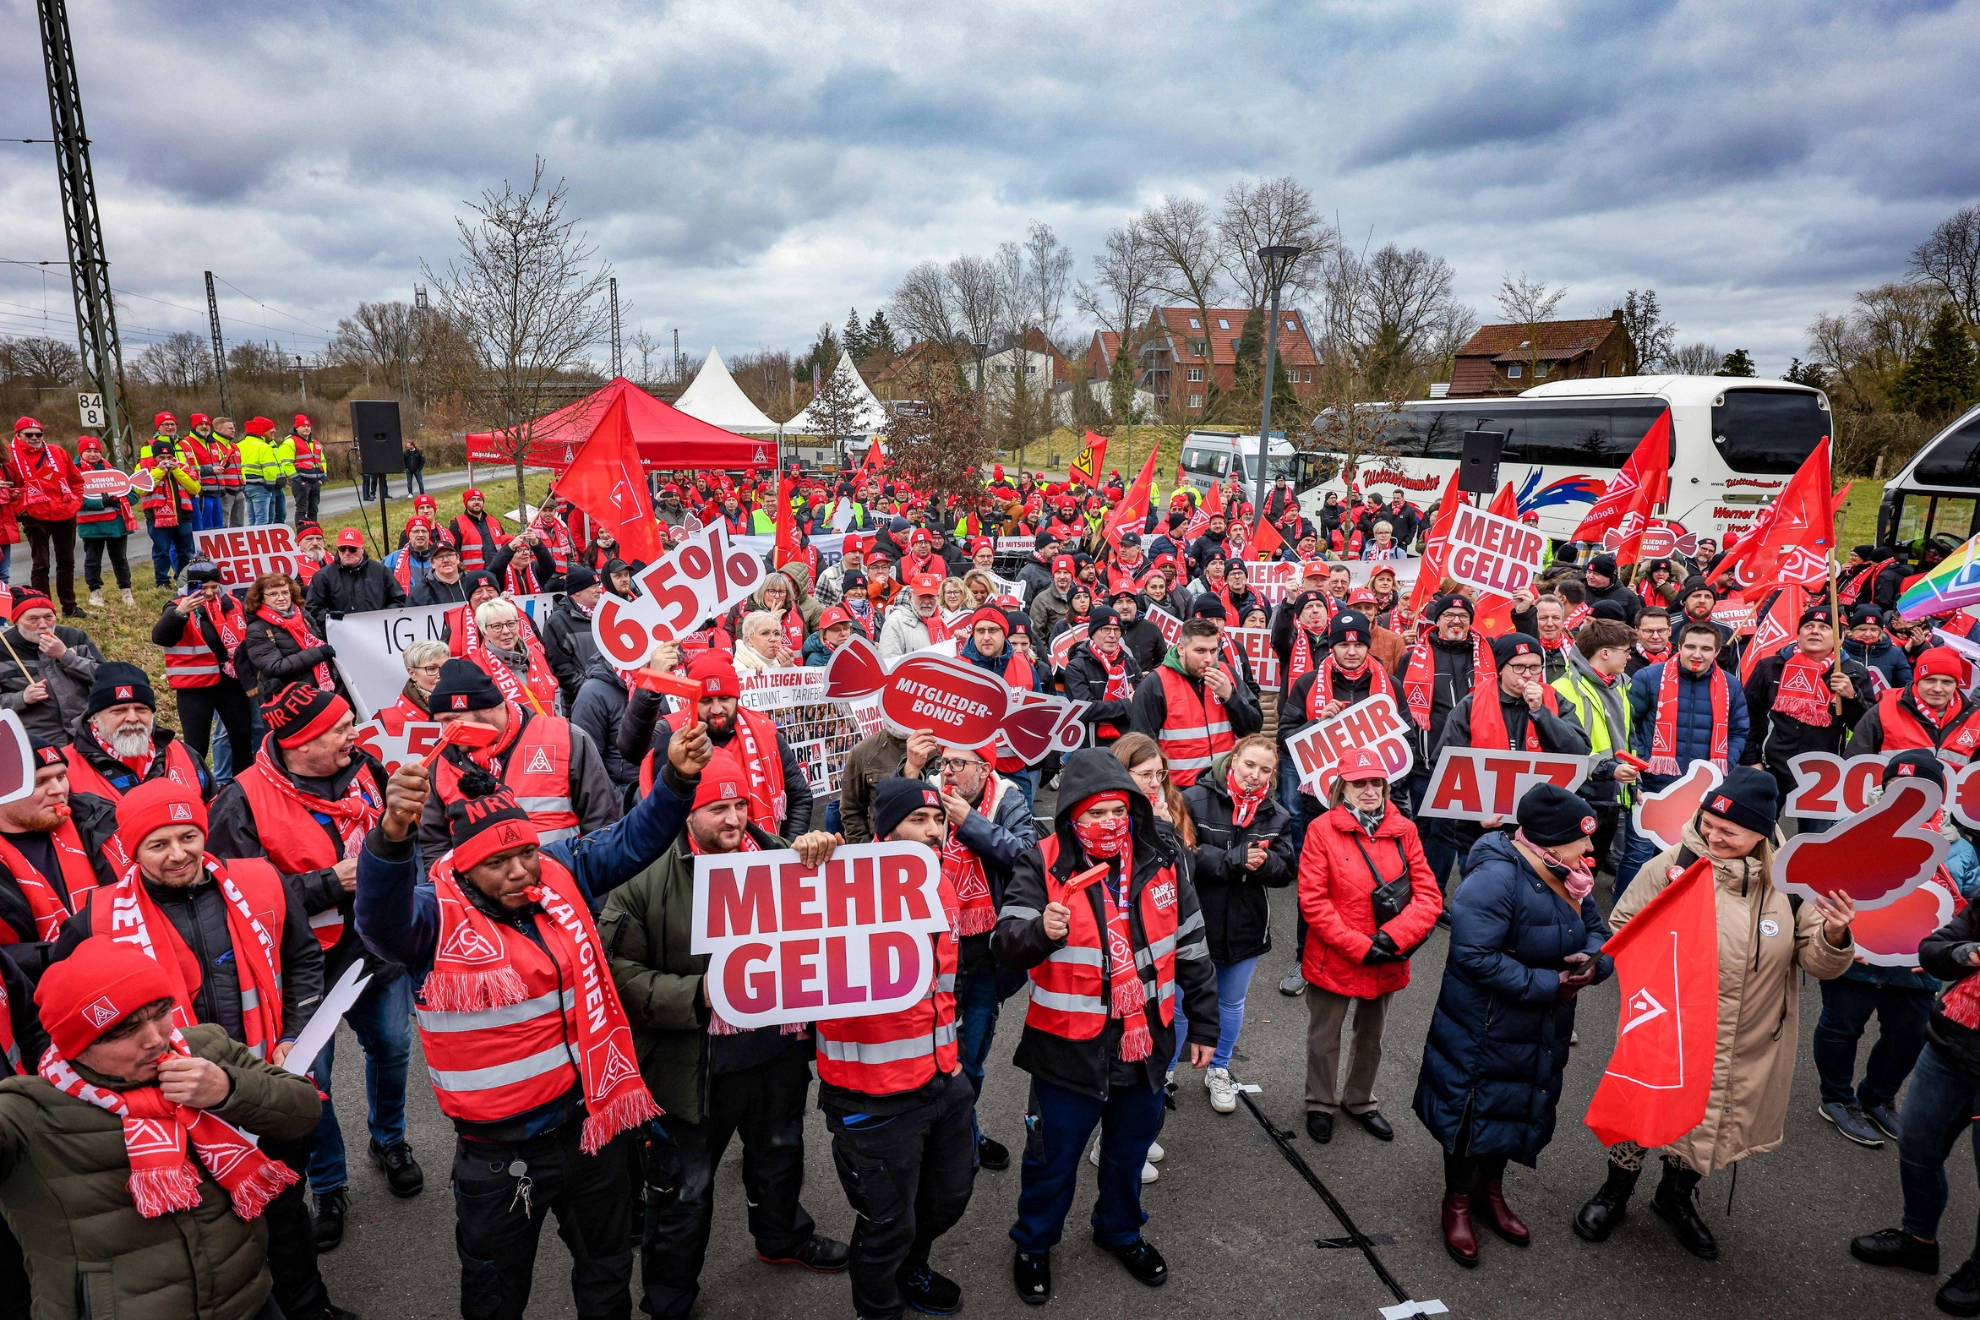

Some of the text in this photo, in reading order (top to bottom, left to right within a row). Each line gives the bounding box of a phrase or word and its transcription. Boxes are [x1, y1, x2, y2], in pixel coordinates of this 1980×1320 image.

[80, 394, 101, 409] 84
[87, 410, 98, 424] 8
[200, 528, 293, 559] MEHR
[1455, 511, 1542, 566] MEHR
[1454, 547, 1528, 594] GELD
[599, 528, 757, 662] 6.5%
[770, 673, 802, 687] ZEIGEN
[895, 677, 993, 718] MITGLIEDER-
[911, 700, 966, 727] BONUS
[1294, 700, 1401, 775] MEHR
[707, 854, 931, 938] MEHR
[723, 931, 920, 1014] GELD
